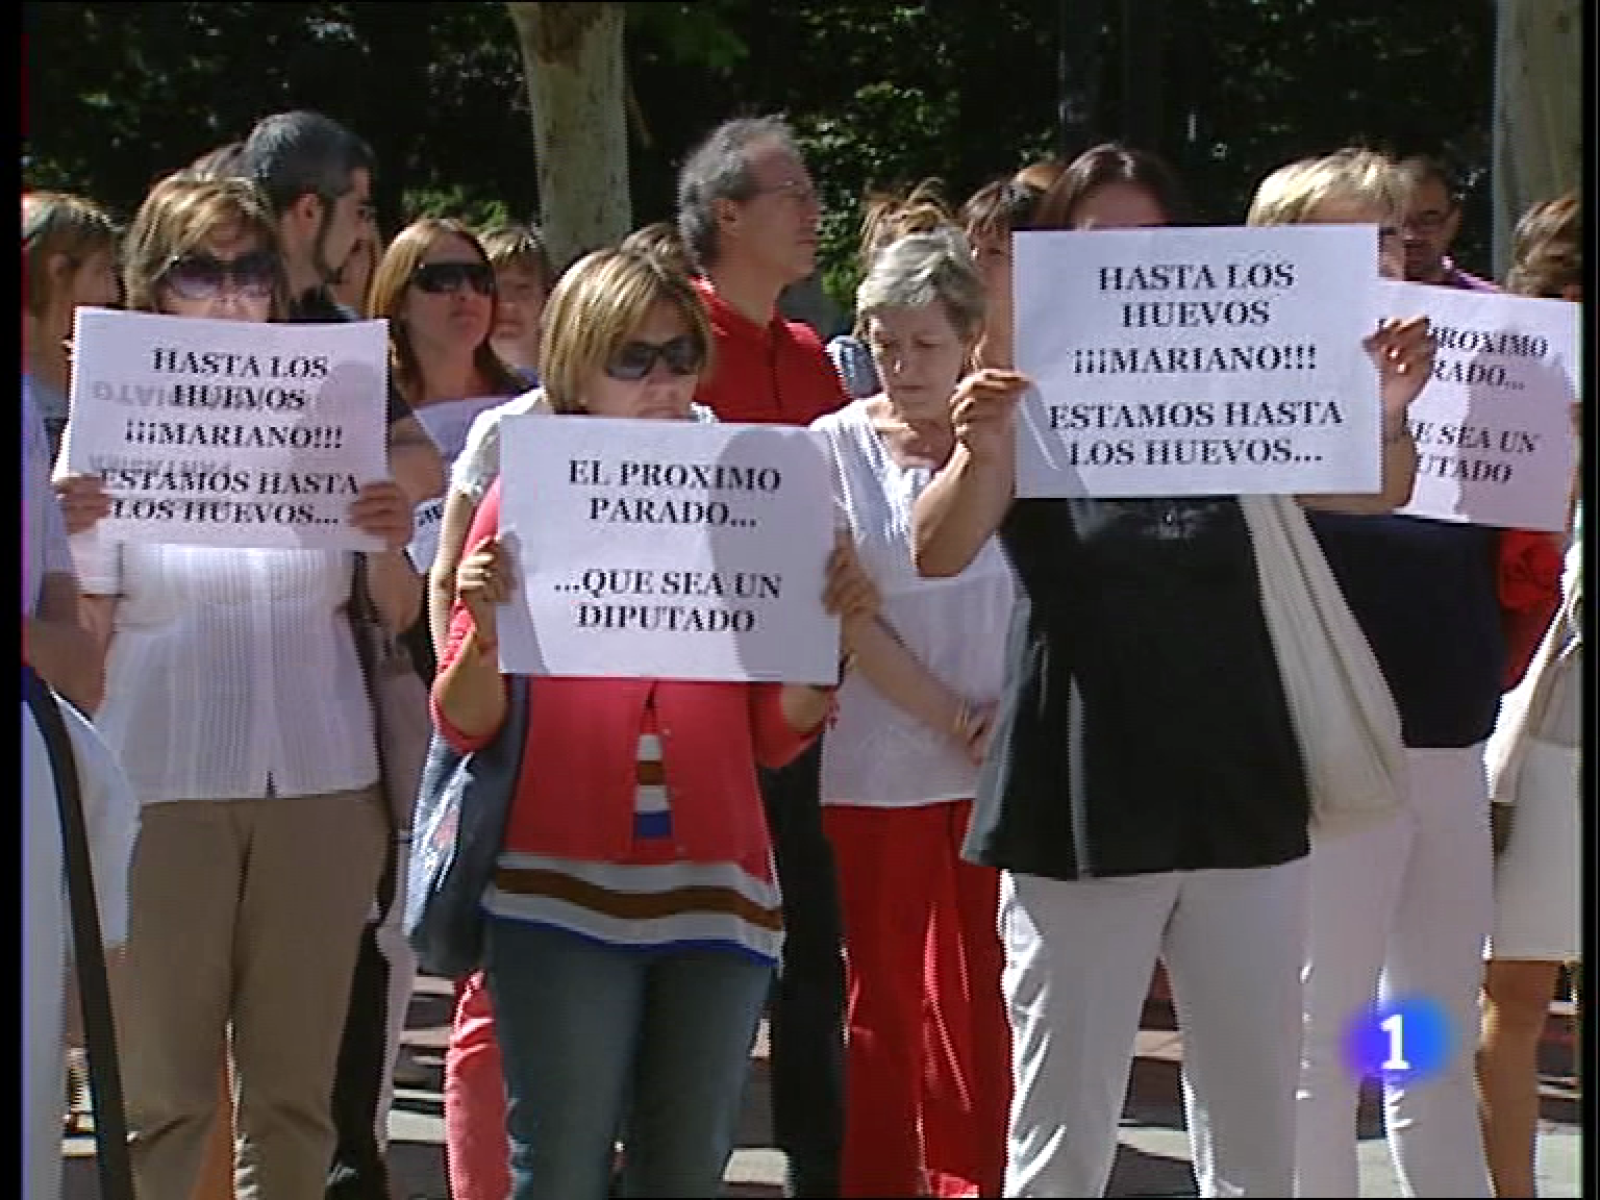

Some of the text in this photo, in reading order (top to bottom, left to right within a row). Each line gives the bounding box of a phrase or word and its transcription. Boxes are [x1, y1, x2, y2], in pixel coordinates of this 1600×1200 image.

[1099, 263, 1295, 291] HASTA LOS
[1122, 300, 1270, 328] HUEVOS
[153, 347, 329, 379] HASTA LOS
[173, 384, 307, 412] HUEVOS
[1050, 400, 1344, 429] ESTAMOS HASTA
[1069, 437, 1323, 466] LOS HUEVOS...
[1438, 424, 1491, 449] SEA
[1499, 430, 1541, 453] UN
[100, 467, 361, 496] ESTAMOS HASTA
[569, 459, 782, 492] EL PROXIMO
[112, 499, 339, 525] LOS HUEVOS...
[590, 497, 757, 528] PARADO...
[553, 569, 783, 599] ...QUE SEA UN
[577, 605, 756, 633] DIPUTADO
